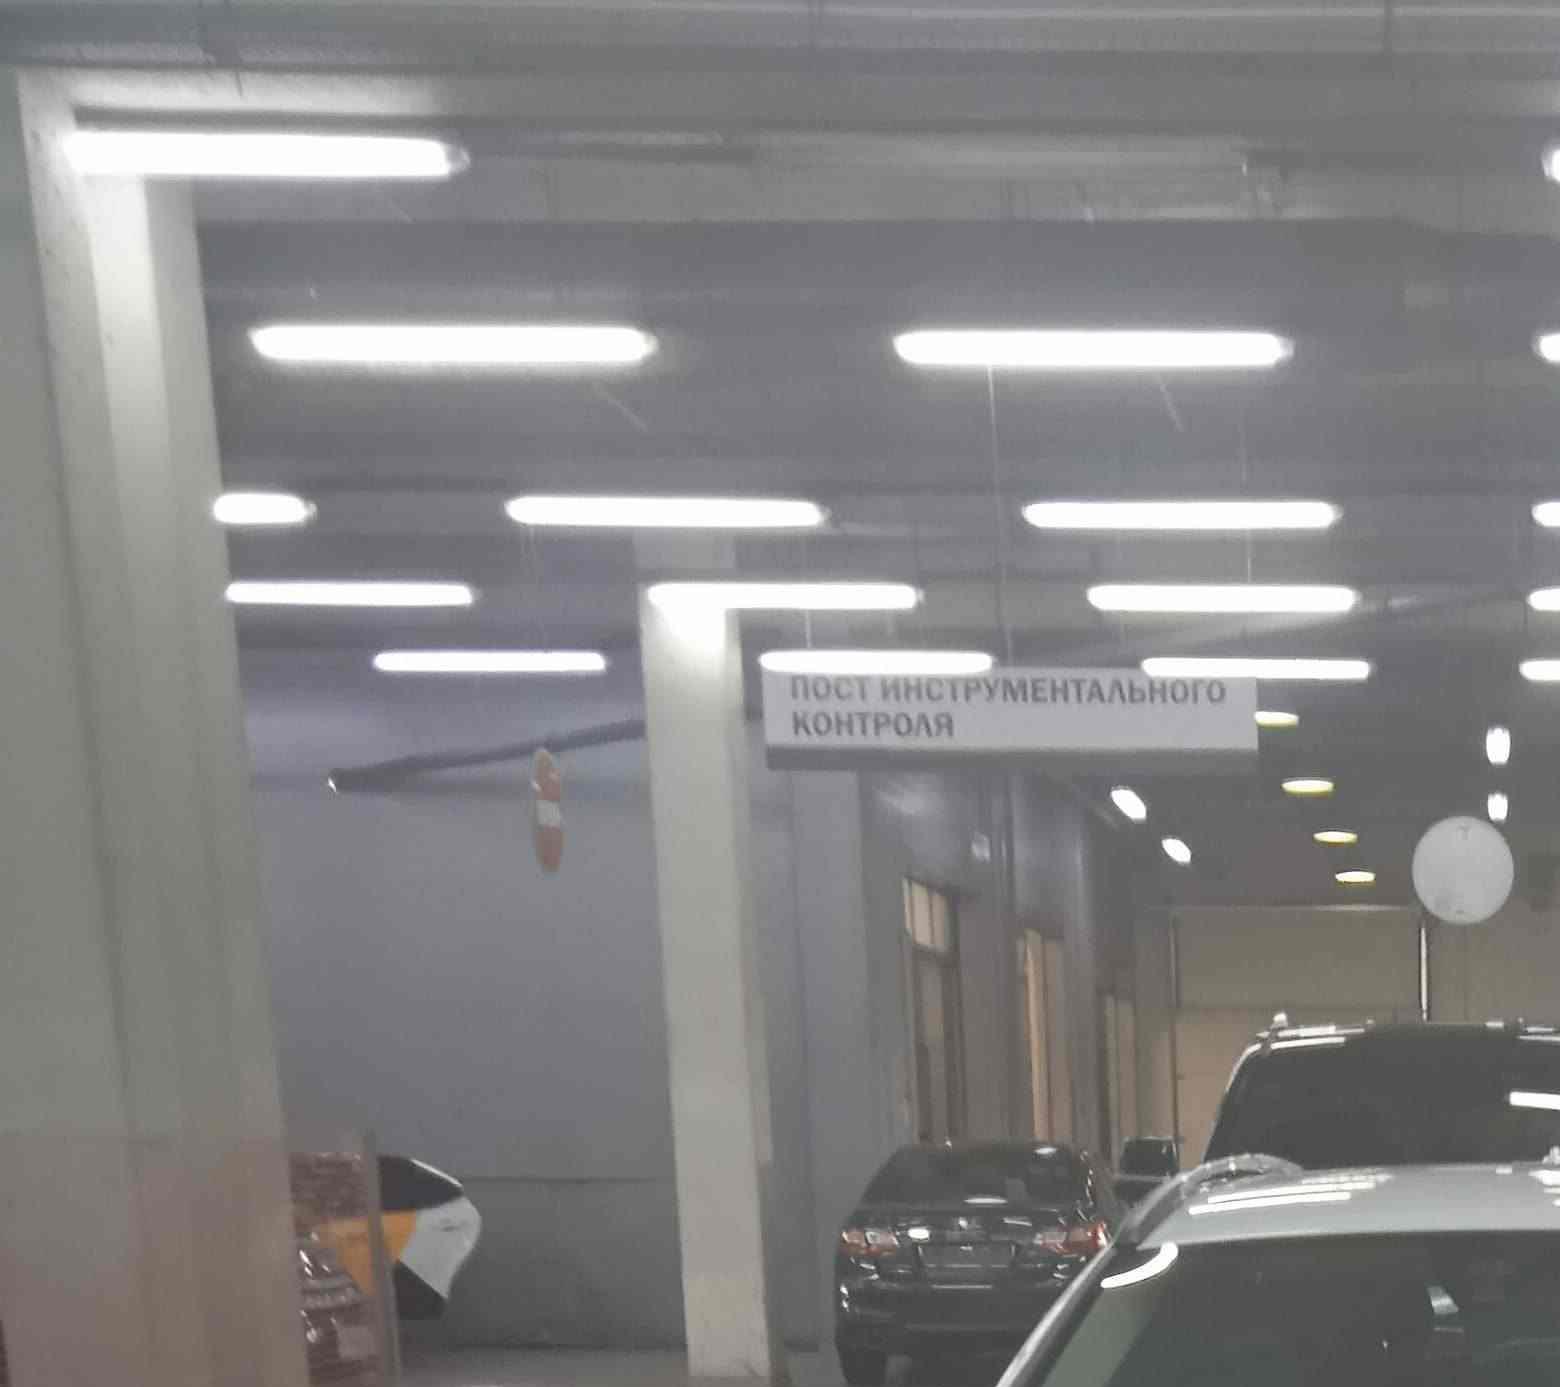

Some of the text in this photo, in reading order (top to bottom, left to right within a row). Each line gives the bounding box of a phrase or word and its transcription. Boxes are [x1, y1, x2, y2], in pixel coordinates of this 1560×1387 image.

[791, 675, 1226, 704] ПОСТ ИНСТРУМЕНТАЛЬНОГО
[792, 711, 954, 737] КОНТРОЛЯ
